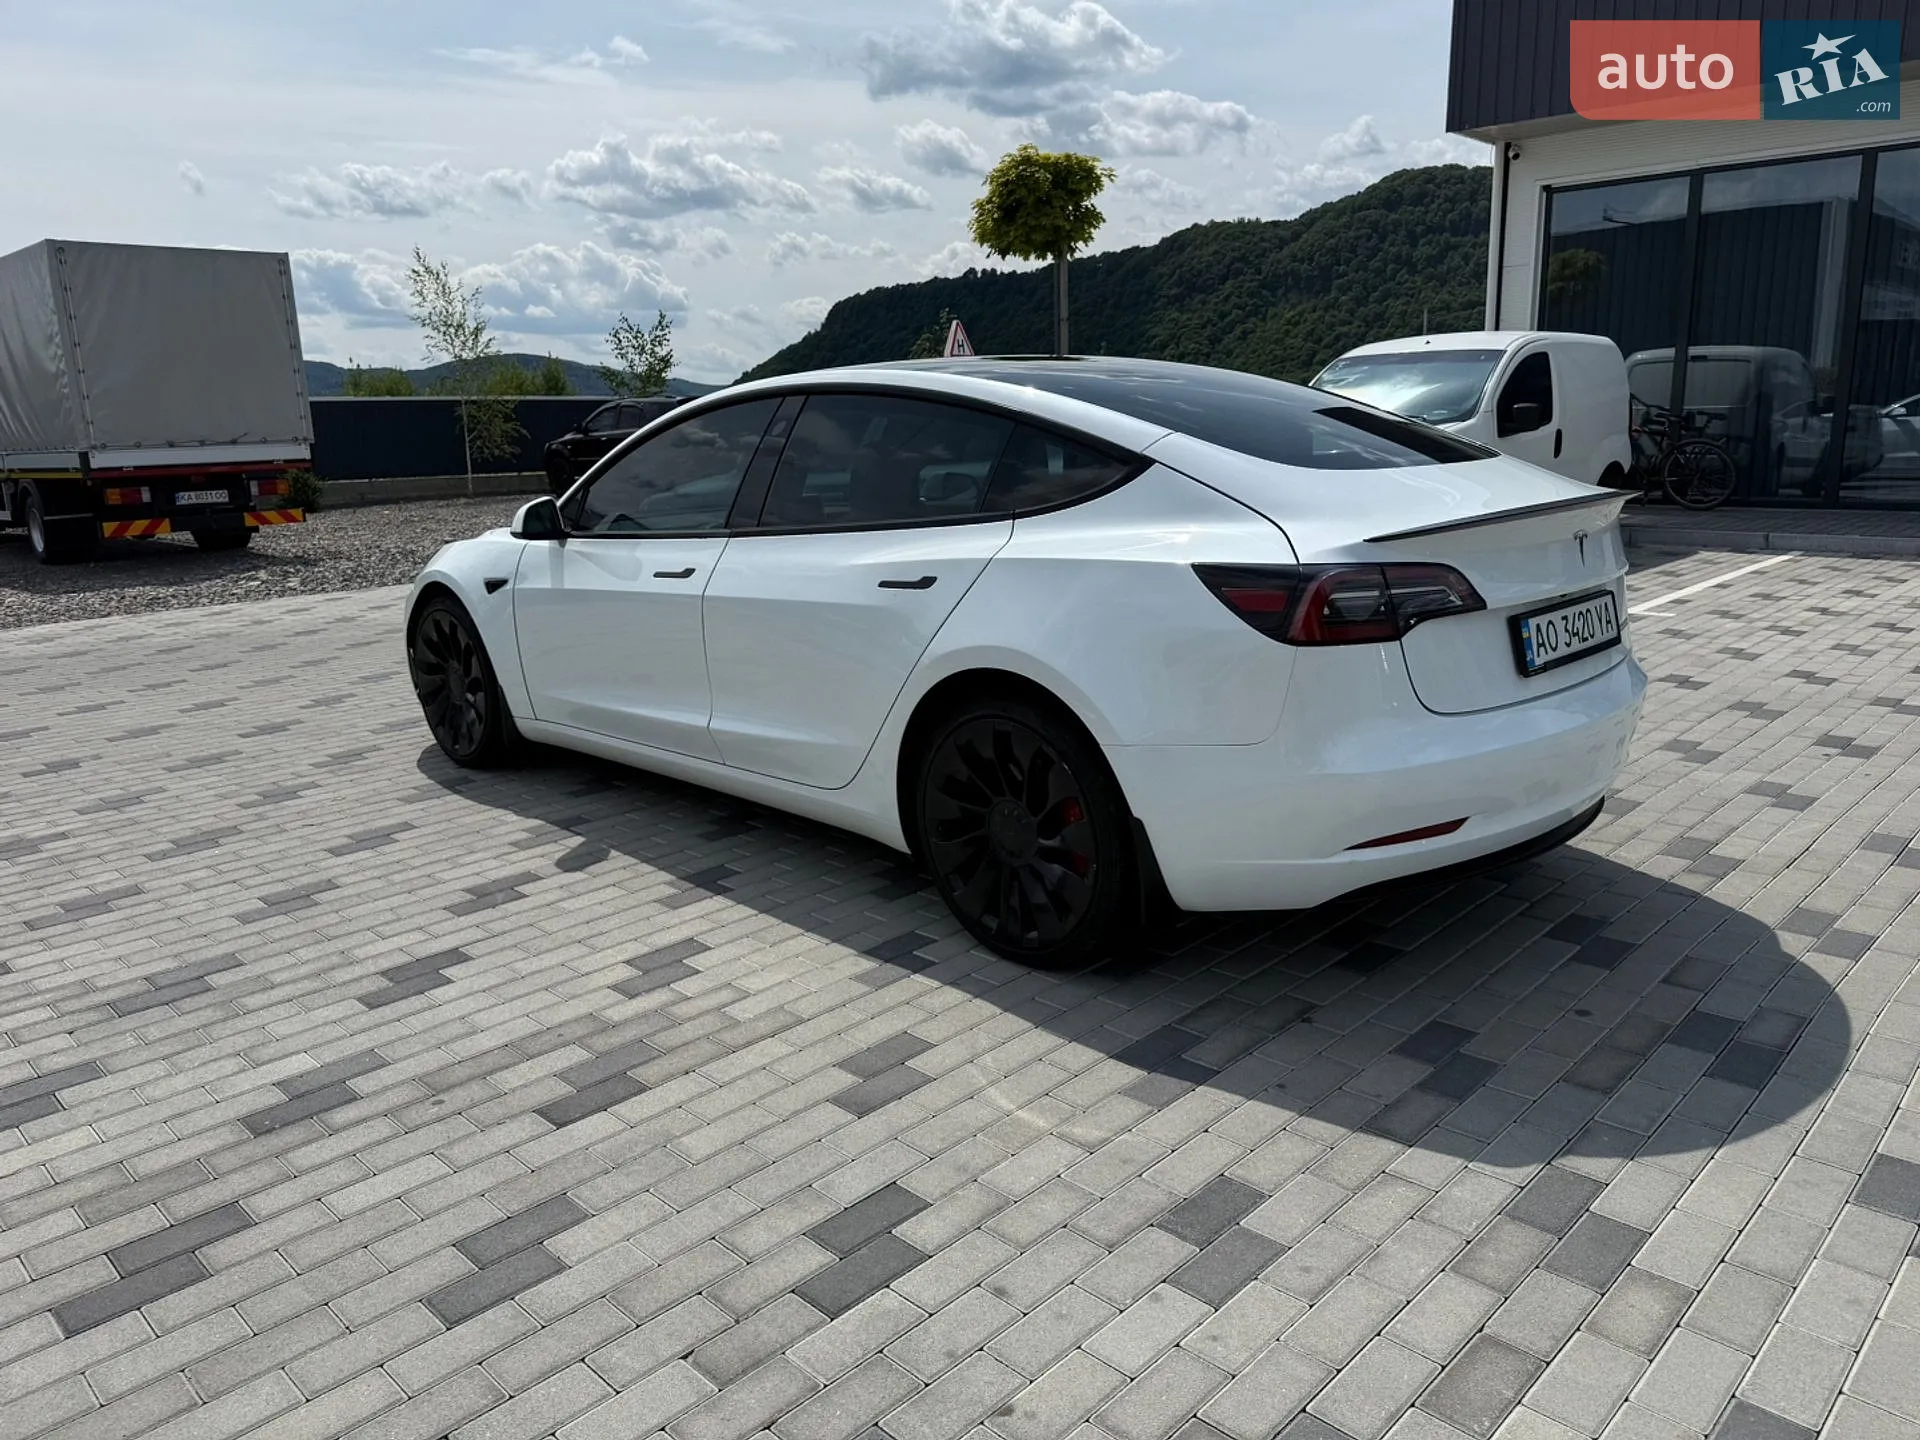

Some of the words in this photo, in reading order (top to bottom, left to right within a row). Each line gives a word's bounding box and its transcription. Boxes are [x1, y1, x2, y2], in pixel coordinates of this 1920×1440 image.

[1535, 619, 1559, 658] AO
[1561, 607, 1595, 648] 3420
[1594, 601, 1615, 637] YA
